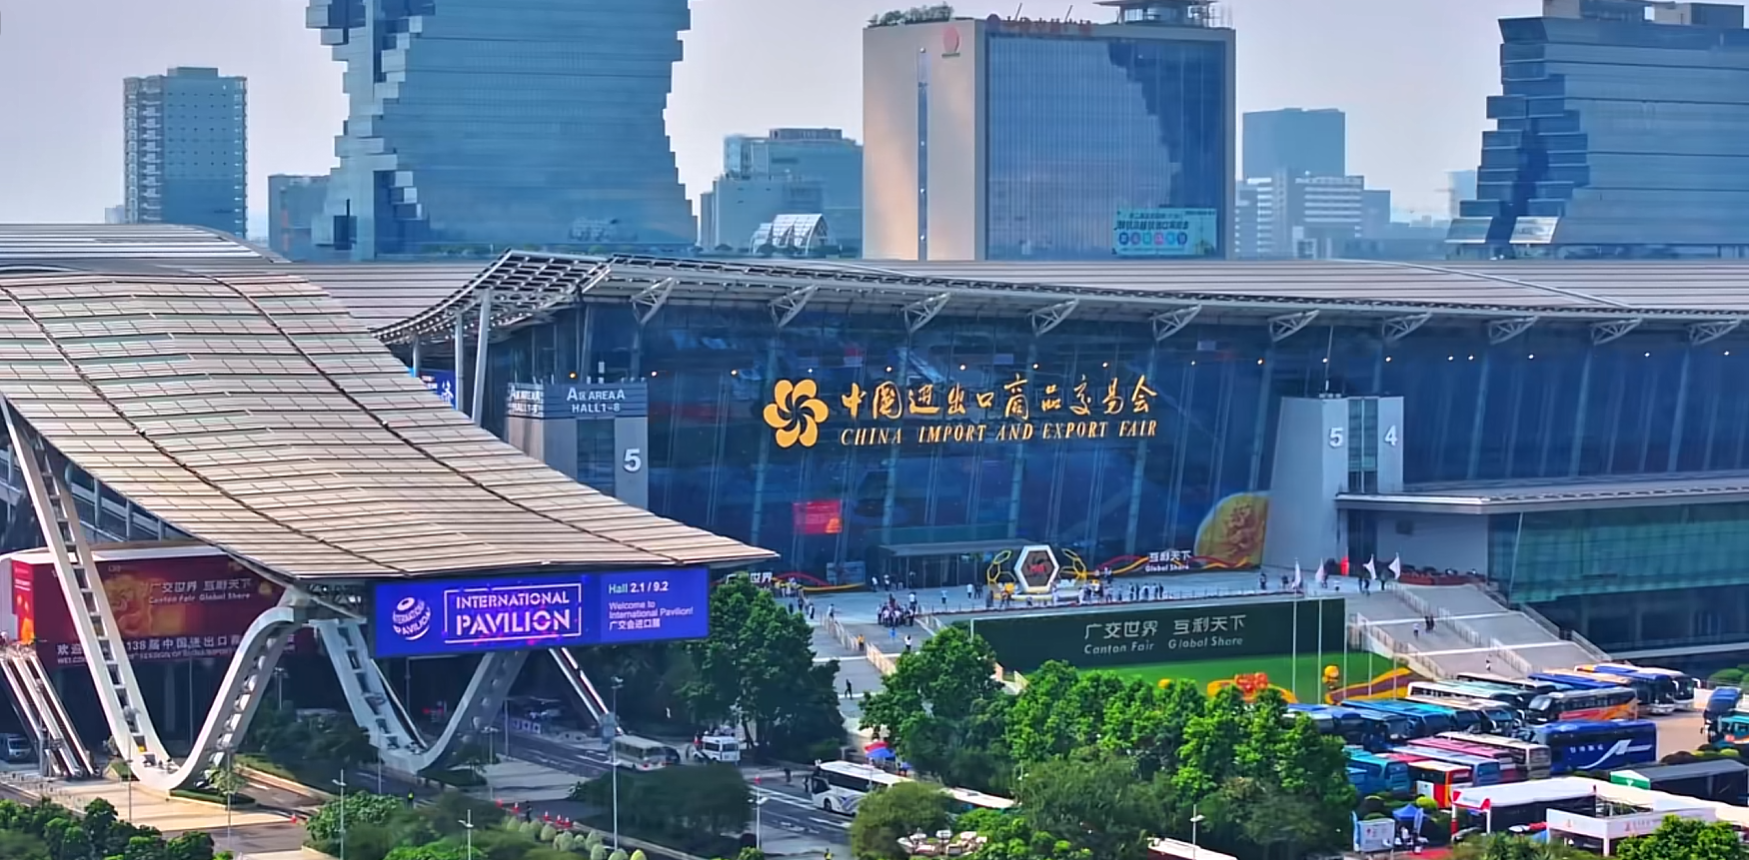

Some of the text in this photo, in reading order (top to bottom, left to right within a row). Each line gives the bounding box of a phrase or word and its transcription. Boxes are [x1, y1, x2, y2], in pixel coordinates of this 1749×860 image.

[841, 420, 1157, 446] CHINA IMPORT AND EXPORT FAIR
[1329, 427, 1344, 447] 5
[1385, 425, 1398, 446] 4
[623, 449, 642, 472] 5
[609, 584, 628, 594] Hall
[630, 583, 645, 593] 2.1
[653, 581, 669, 592] 9.2
[456, 591, 570, 609] INTERNATIONAL
[609, 600, 656, 610] Welcome to
[456, 609, 570, 635] PAVILION
[609, 608, 659, 619] International
[1085, 614, 1246, 640] 广交世界 互利天下
[1084, 635, 1243, 655] Canton Fair Global Share
